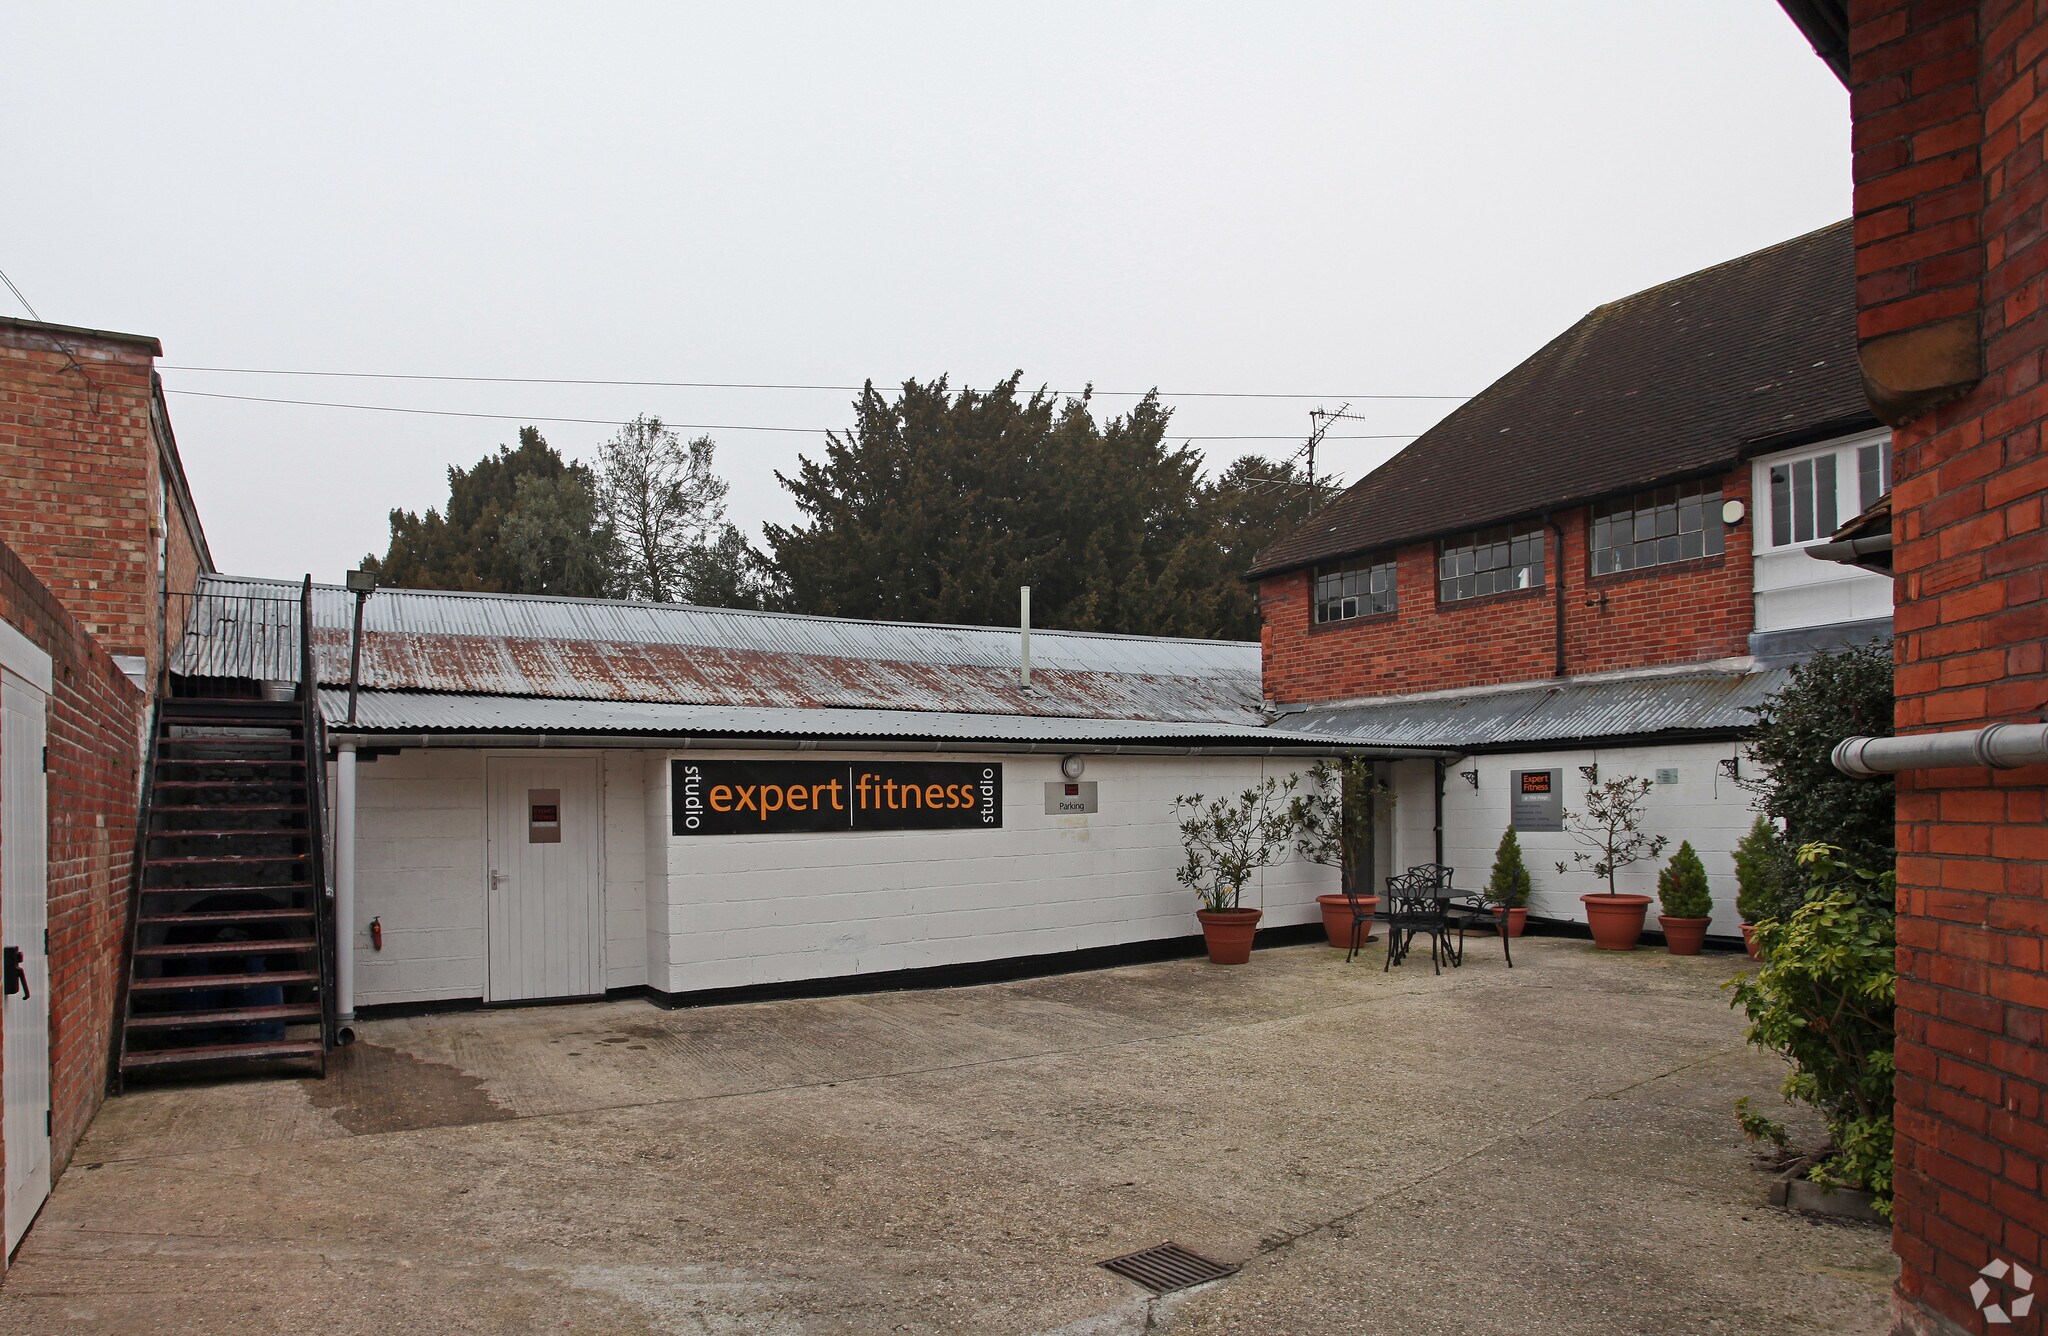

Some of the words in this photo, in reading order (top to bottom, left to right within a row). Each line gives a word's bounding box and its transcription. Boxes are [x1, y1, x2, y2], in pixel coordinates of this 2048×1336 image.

[1523, 775, 1549, 784] Expert
[1523, 783, 1549, 791] Fitness
[684, 765, 703, 830] studio
[709, 778, 844, 821] expert
[855, 773, 975, 810] fitness
[979, 767, 994, 824] studio
[1059, 801, 1085, 812] Parking
